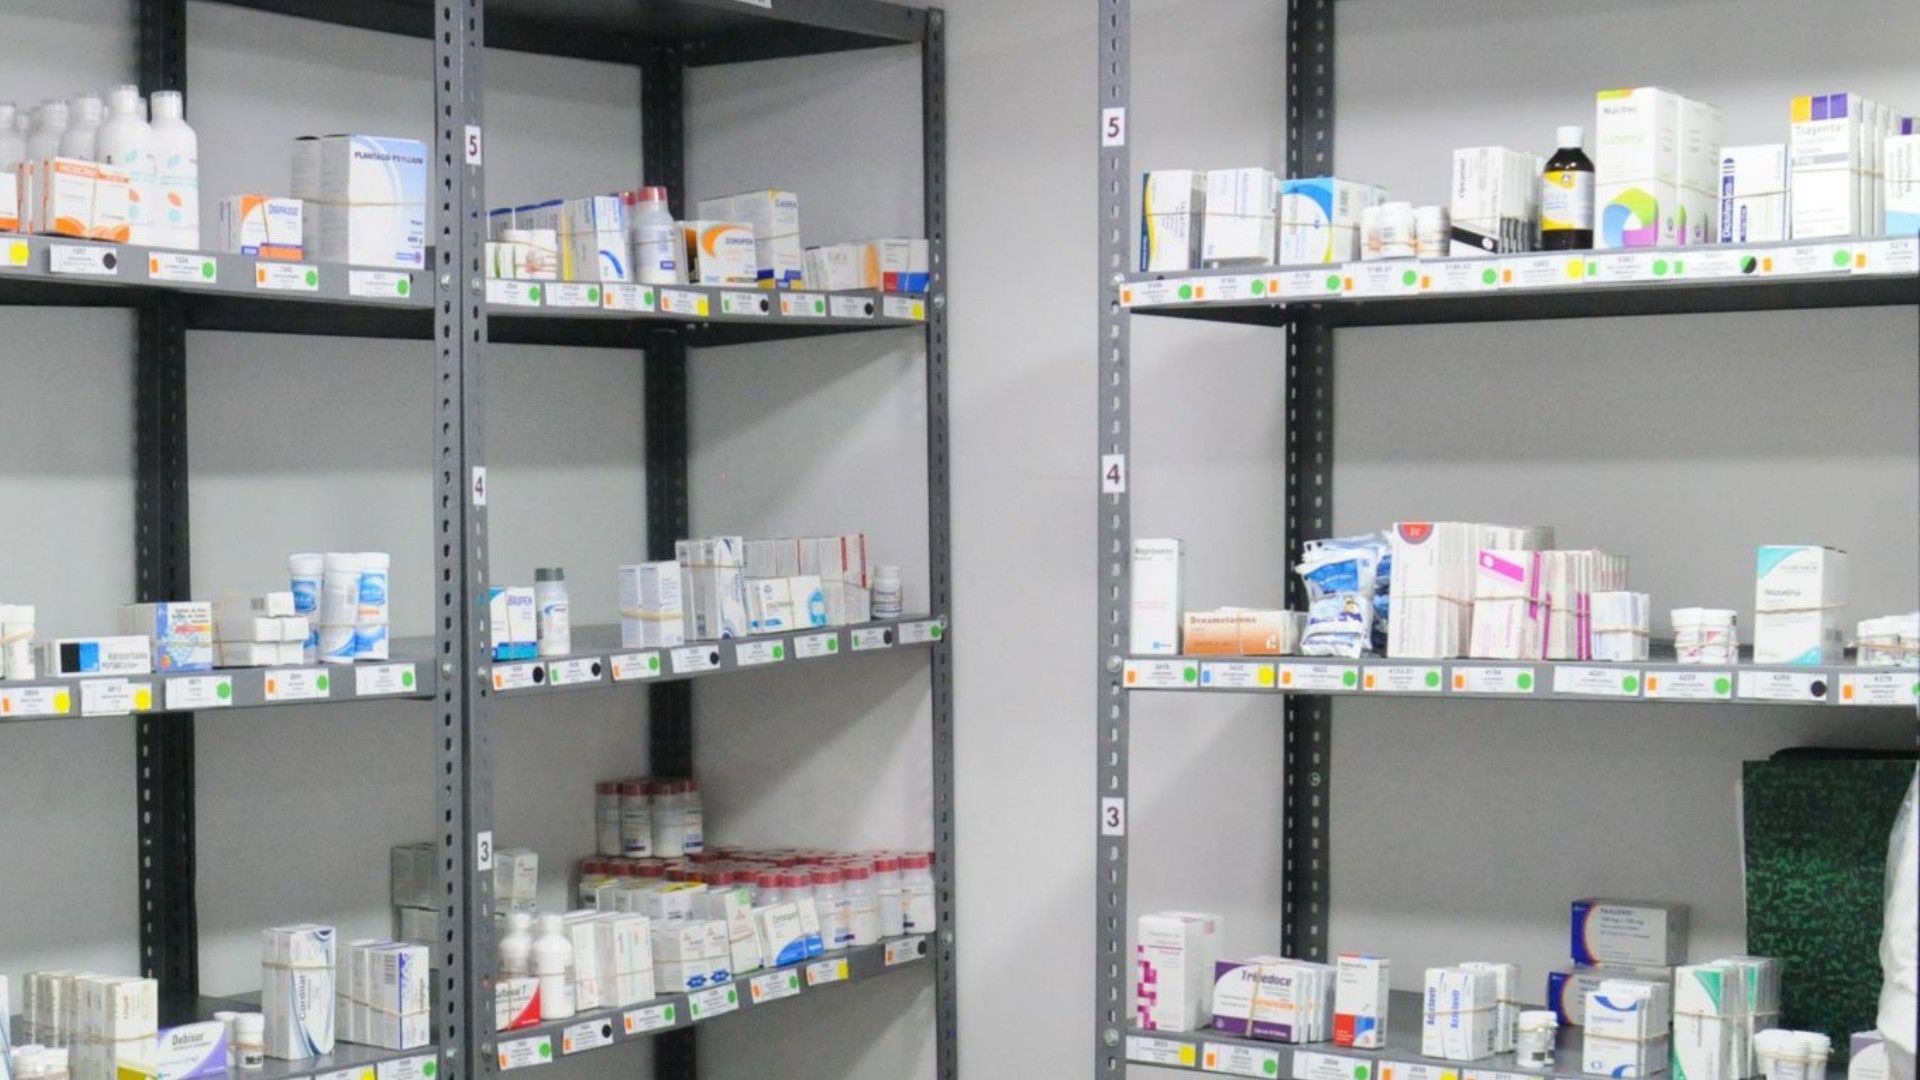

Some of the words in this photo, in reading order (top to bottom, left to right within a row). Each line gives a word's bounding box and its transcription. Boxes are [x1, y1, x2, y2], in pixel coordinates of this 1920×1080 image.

[1107, 117, 1120, 138] 5
[469, 135, 477, 156] 5
[1106, 463, 1120, 484] 4
[475, 477, 483, 498] 4
[1107, 807, 1120, 828] 3
[480, 841, 489, 862] 3
